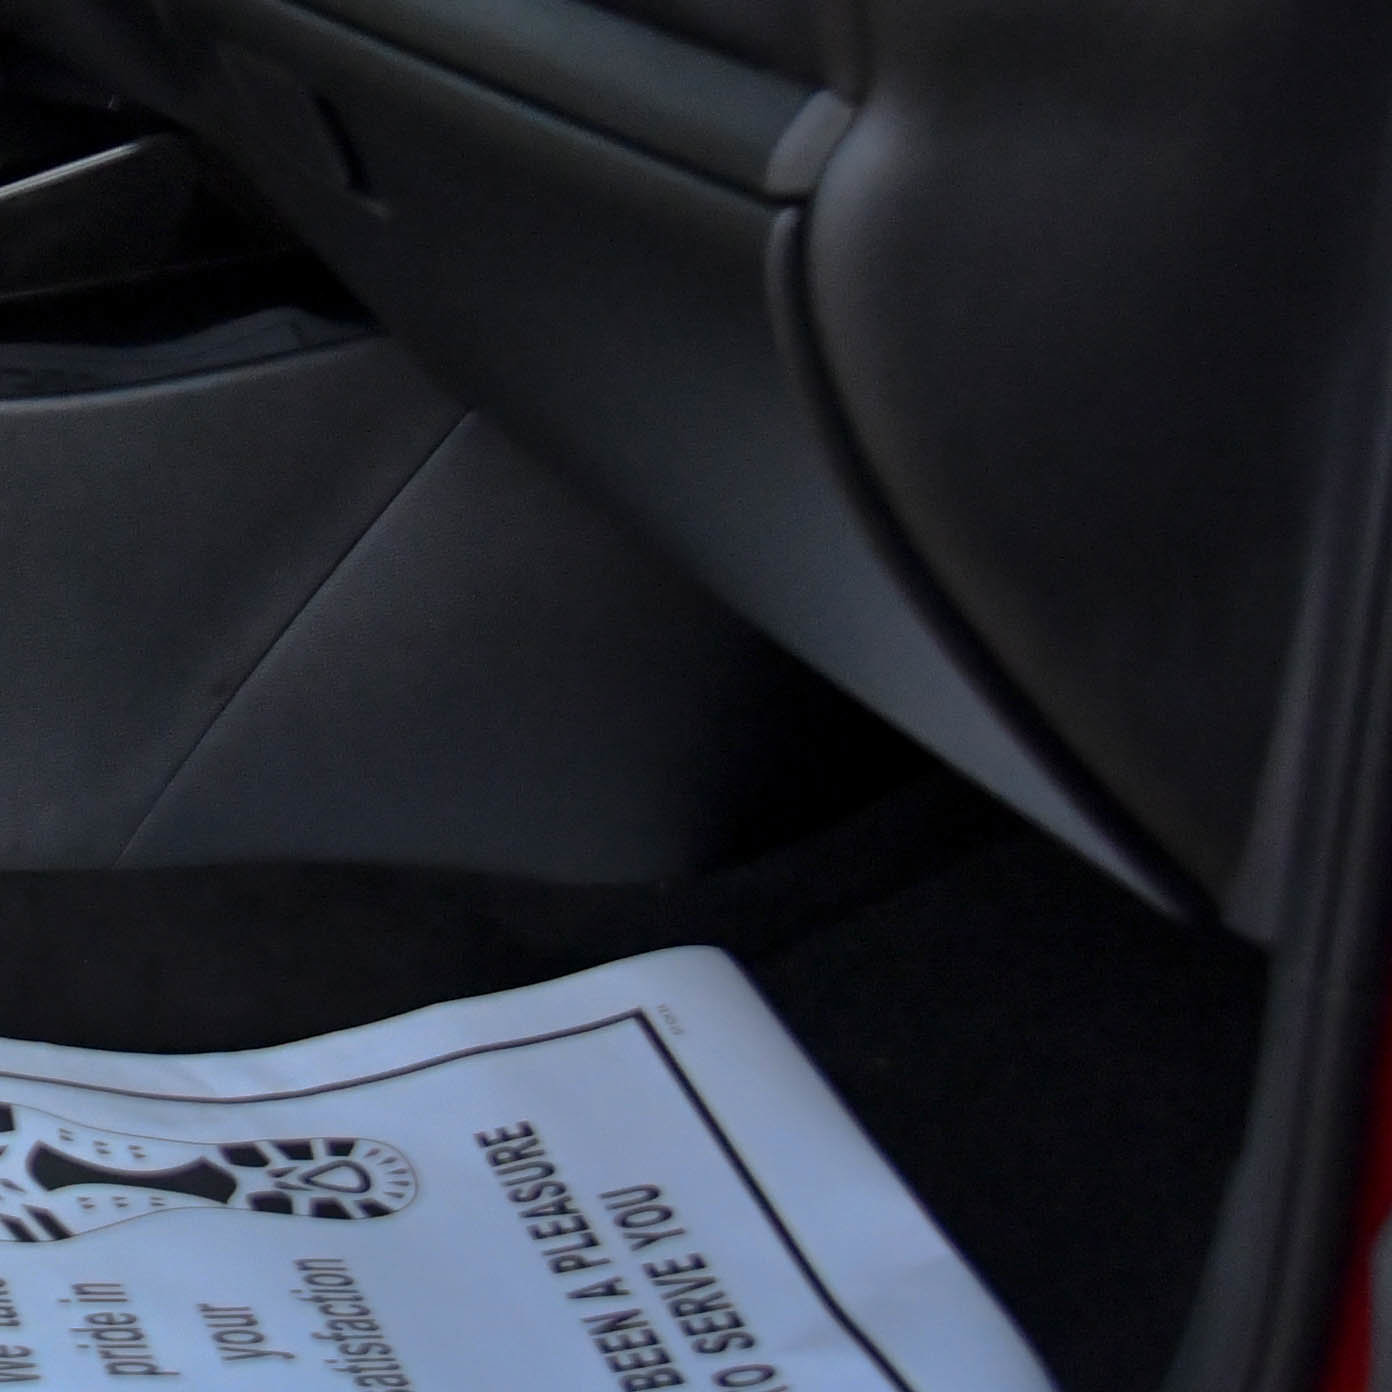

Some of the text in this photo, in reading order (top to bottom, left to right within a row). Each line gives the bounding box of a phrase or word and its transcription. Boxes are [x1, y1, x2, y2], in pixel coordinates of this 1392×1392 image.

[472, 1119, 685, 1392] BEEN A PLEASURE
[597, 1184, 688, 1252] YOU
[58, 1281, 182, 1378] pride in
[195, 1303, 297, 1363] your
[641, 1253, 756, 1356] SERVE
